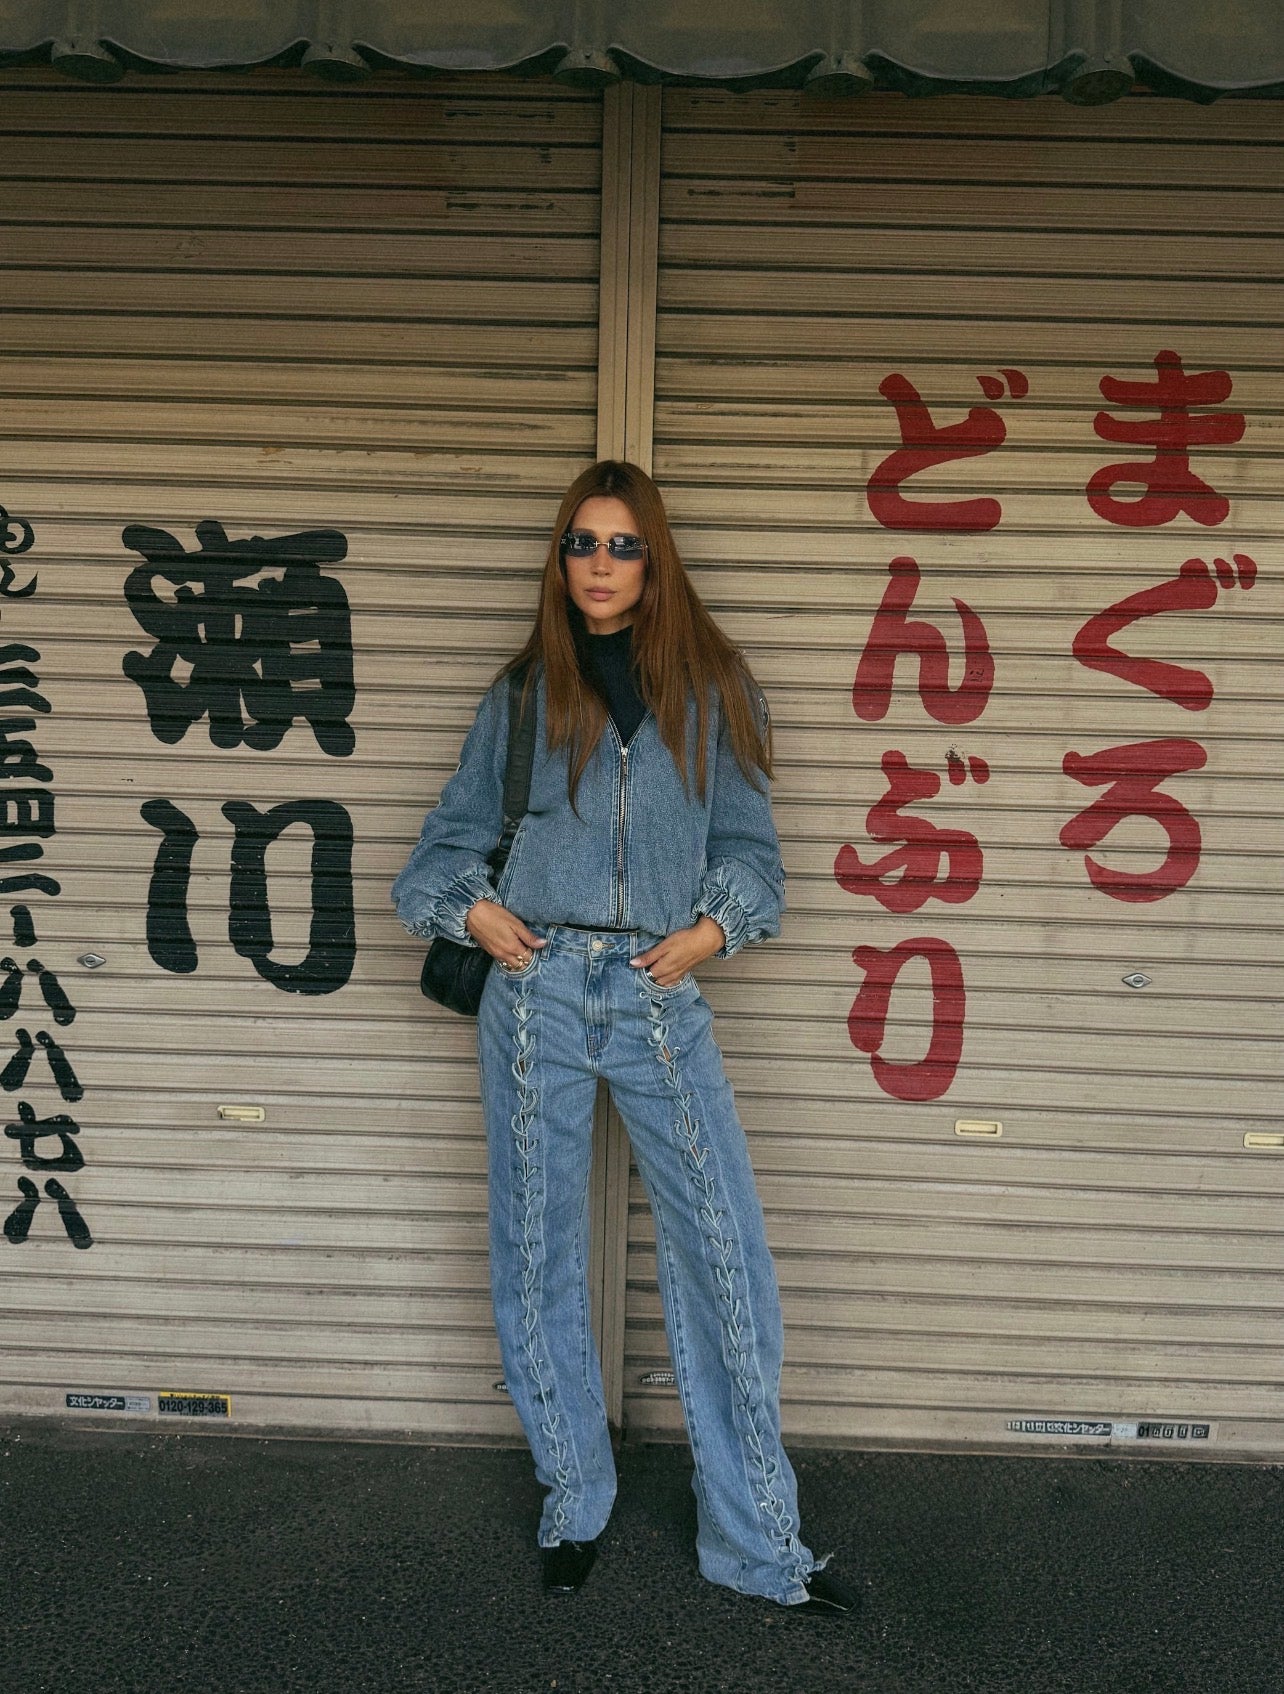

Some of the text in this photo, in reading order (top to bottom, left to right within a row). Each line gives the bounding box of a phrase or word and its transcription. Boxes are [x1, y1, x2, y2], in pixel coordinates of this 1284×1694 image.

[834, 369, 1028, 1101] どんぶり
[1059, 350, 1257, 903] まぐろ
[159, 1399, 228, 1414] 0120-129-365
